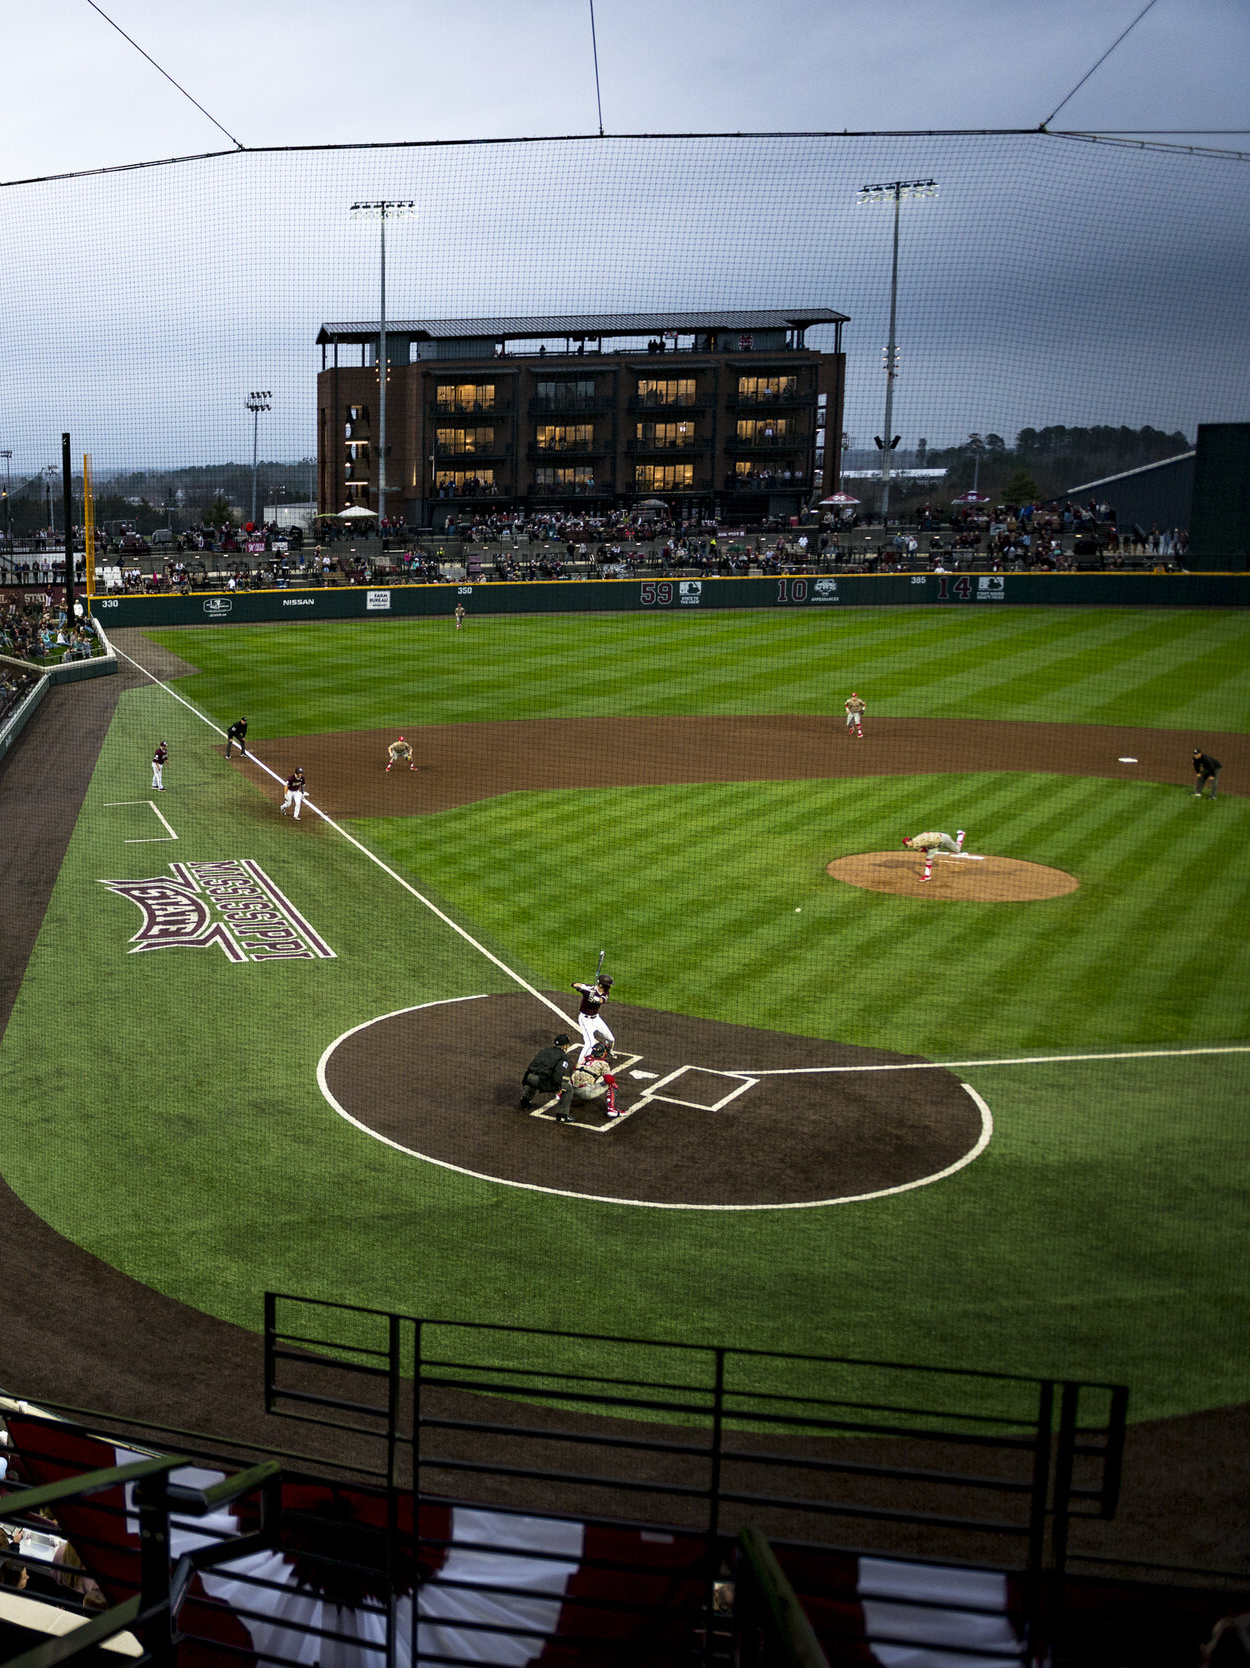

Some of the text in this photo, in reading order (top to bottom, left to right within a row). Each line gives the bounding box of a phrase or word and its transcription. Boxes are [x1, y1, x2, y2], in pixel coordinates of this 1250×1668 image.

[457, 586, 473, 595] 350
[776, 578, 808, 602] 10
[910, 576, 927, 584] 385
[937, 575, 973, 600] 14
[101, 599, 119, 608] 330
[282, 598, 315, 606] NISSAN
[640, 581, 674, 605] 59
[130, 887, 199, 936] STATE
[186, 859, 316, 962] MISSISSIPPI
